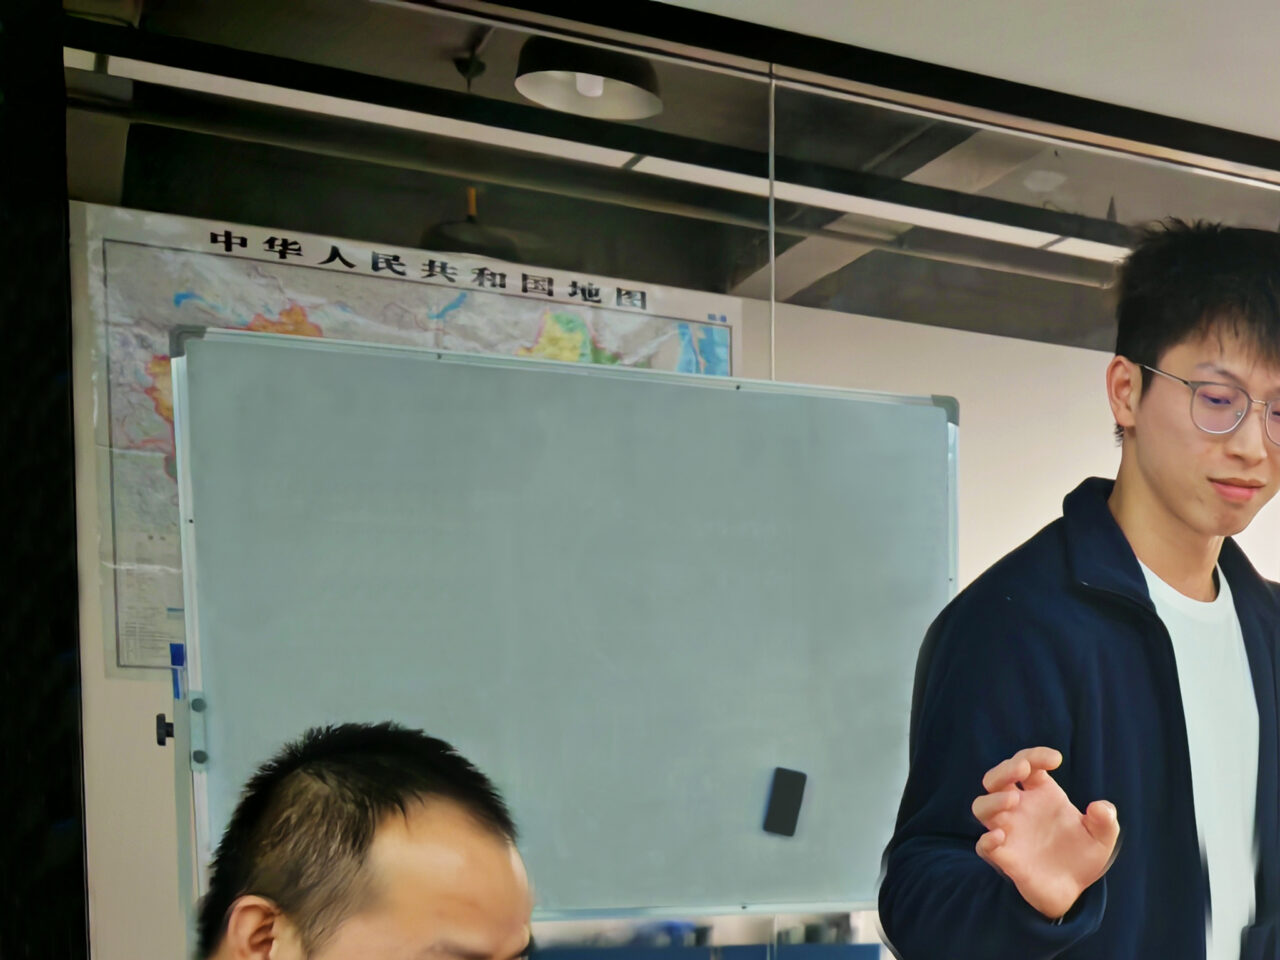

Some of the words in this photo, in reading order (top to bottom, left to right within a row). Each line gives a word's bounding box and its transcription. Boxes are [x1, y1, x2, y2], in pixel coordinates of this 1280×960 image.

[210, 230, 648, 311] 中华人民共和国地图
